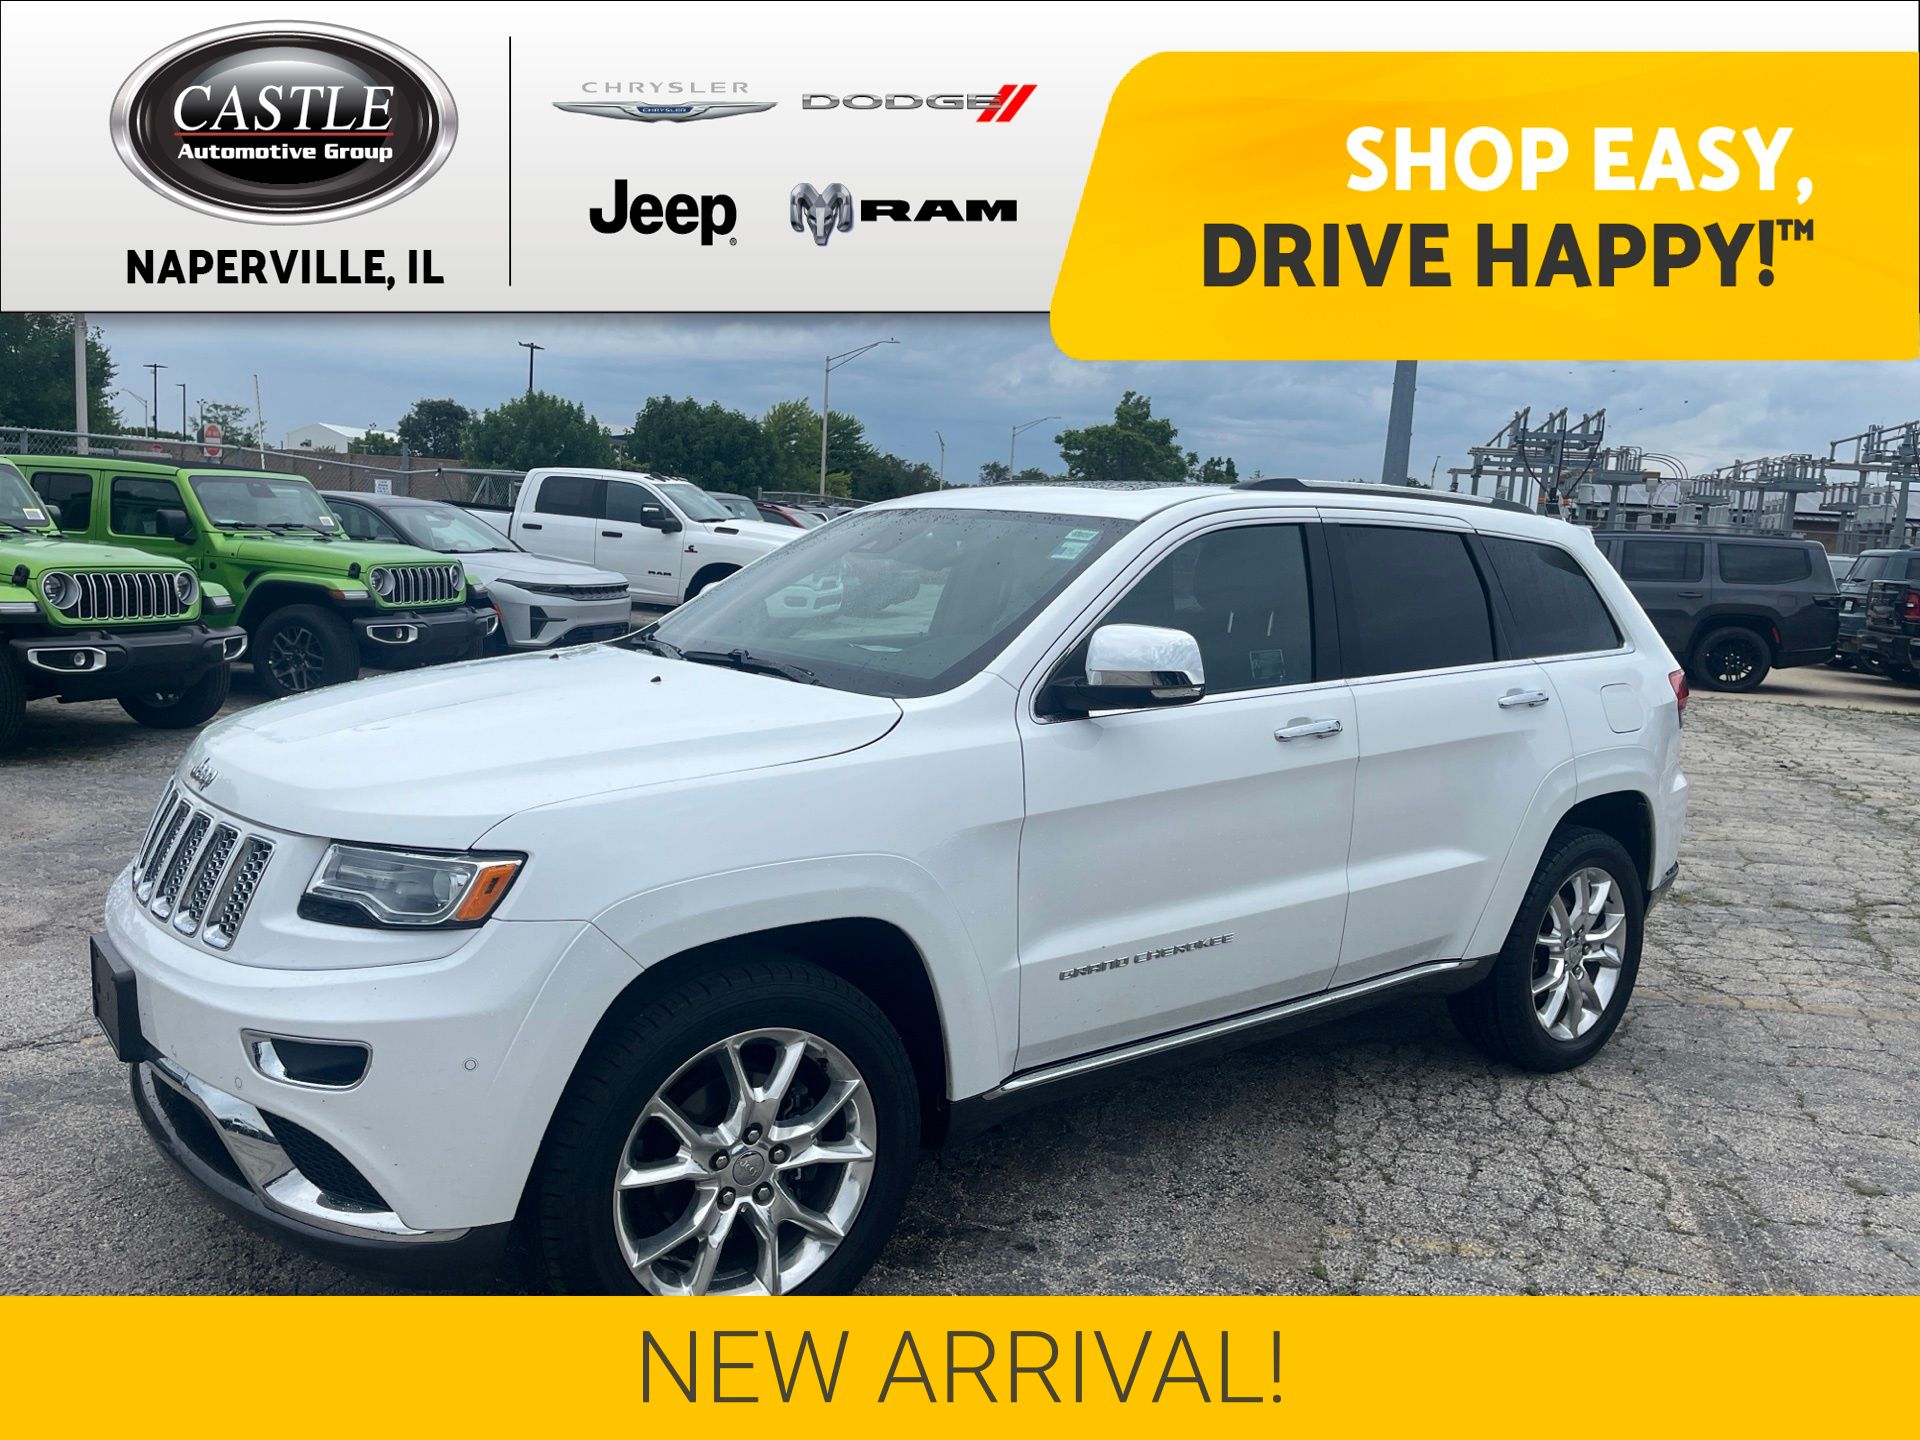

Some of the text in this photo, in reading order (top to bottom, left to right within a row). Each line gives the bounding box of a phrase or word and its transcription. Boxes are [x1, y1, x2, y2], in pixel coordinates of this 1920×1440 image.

[190, 757, 218, 791] Jeep
[1059, 932, 1235, 981] GRAND CHEROKEE
